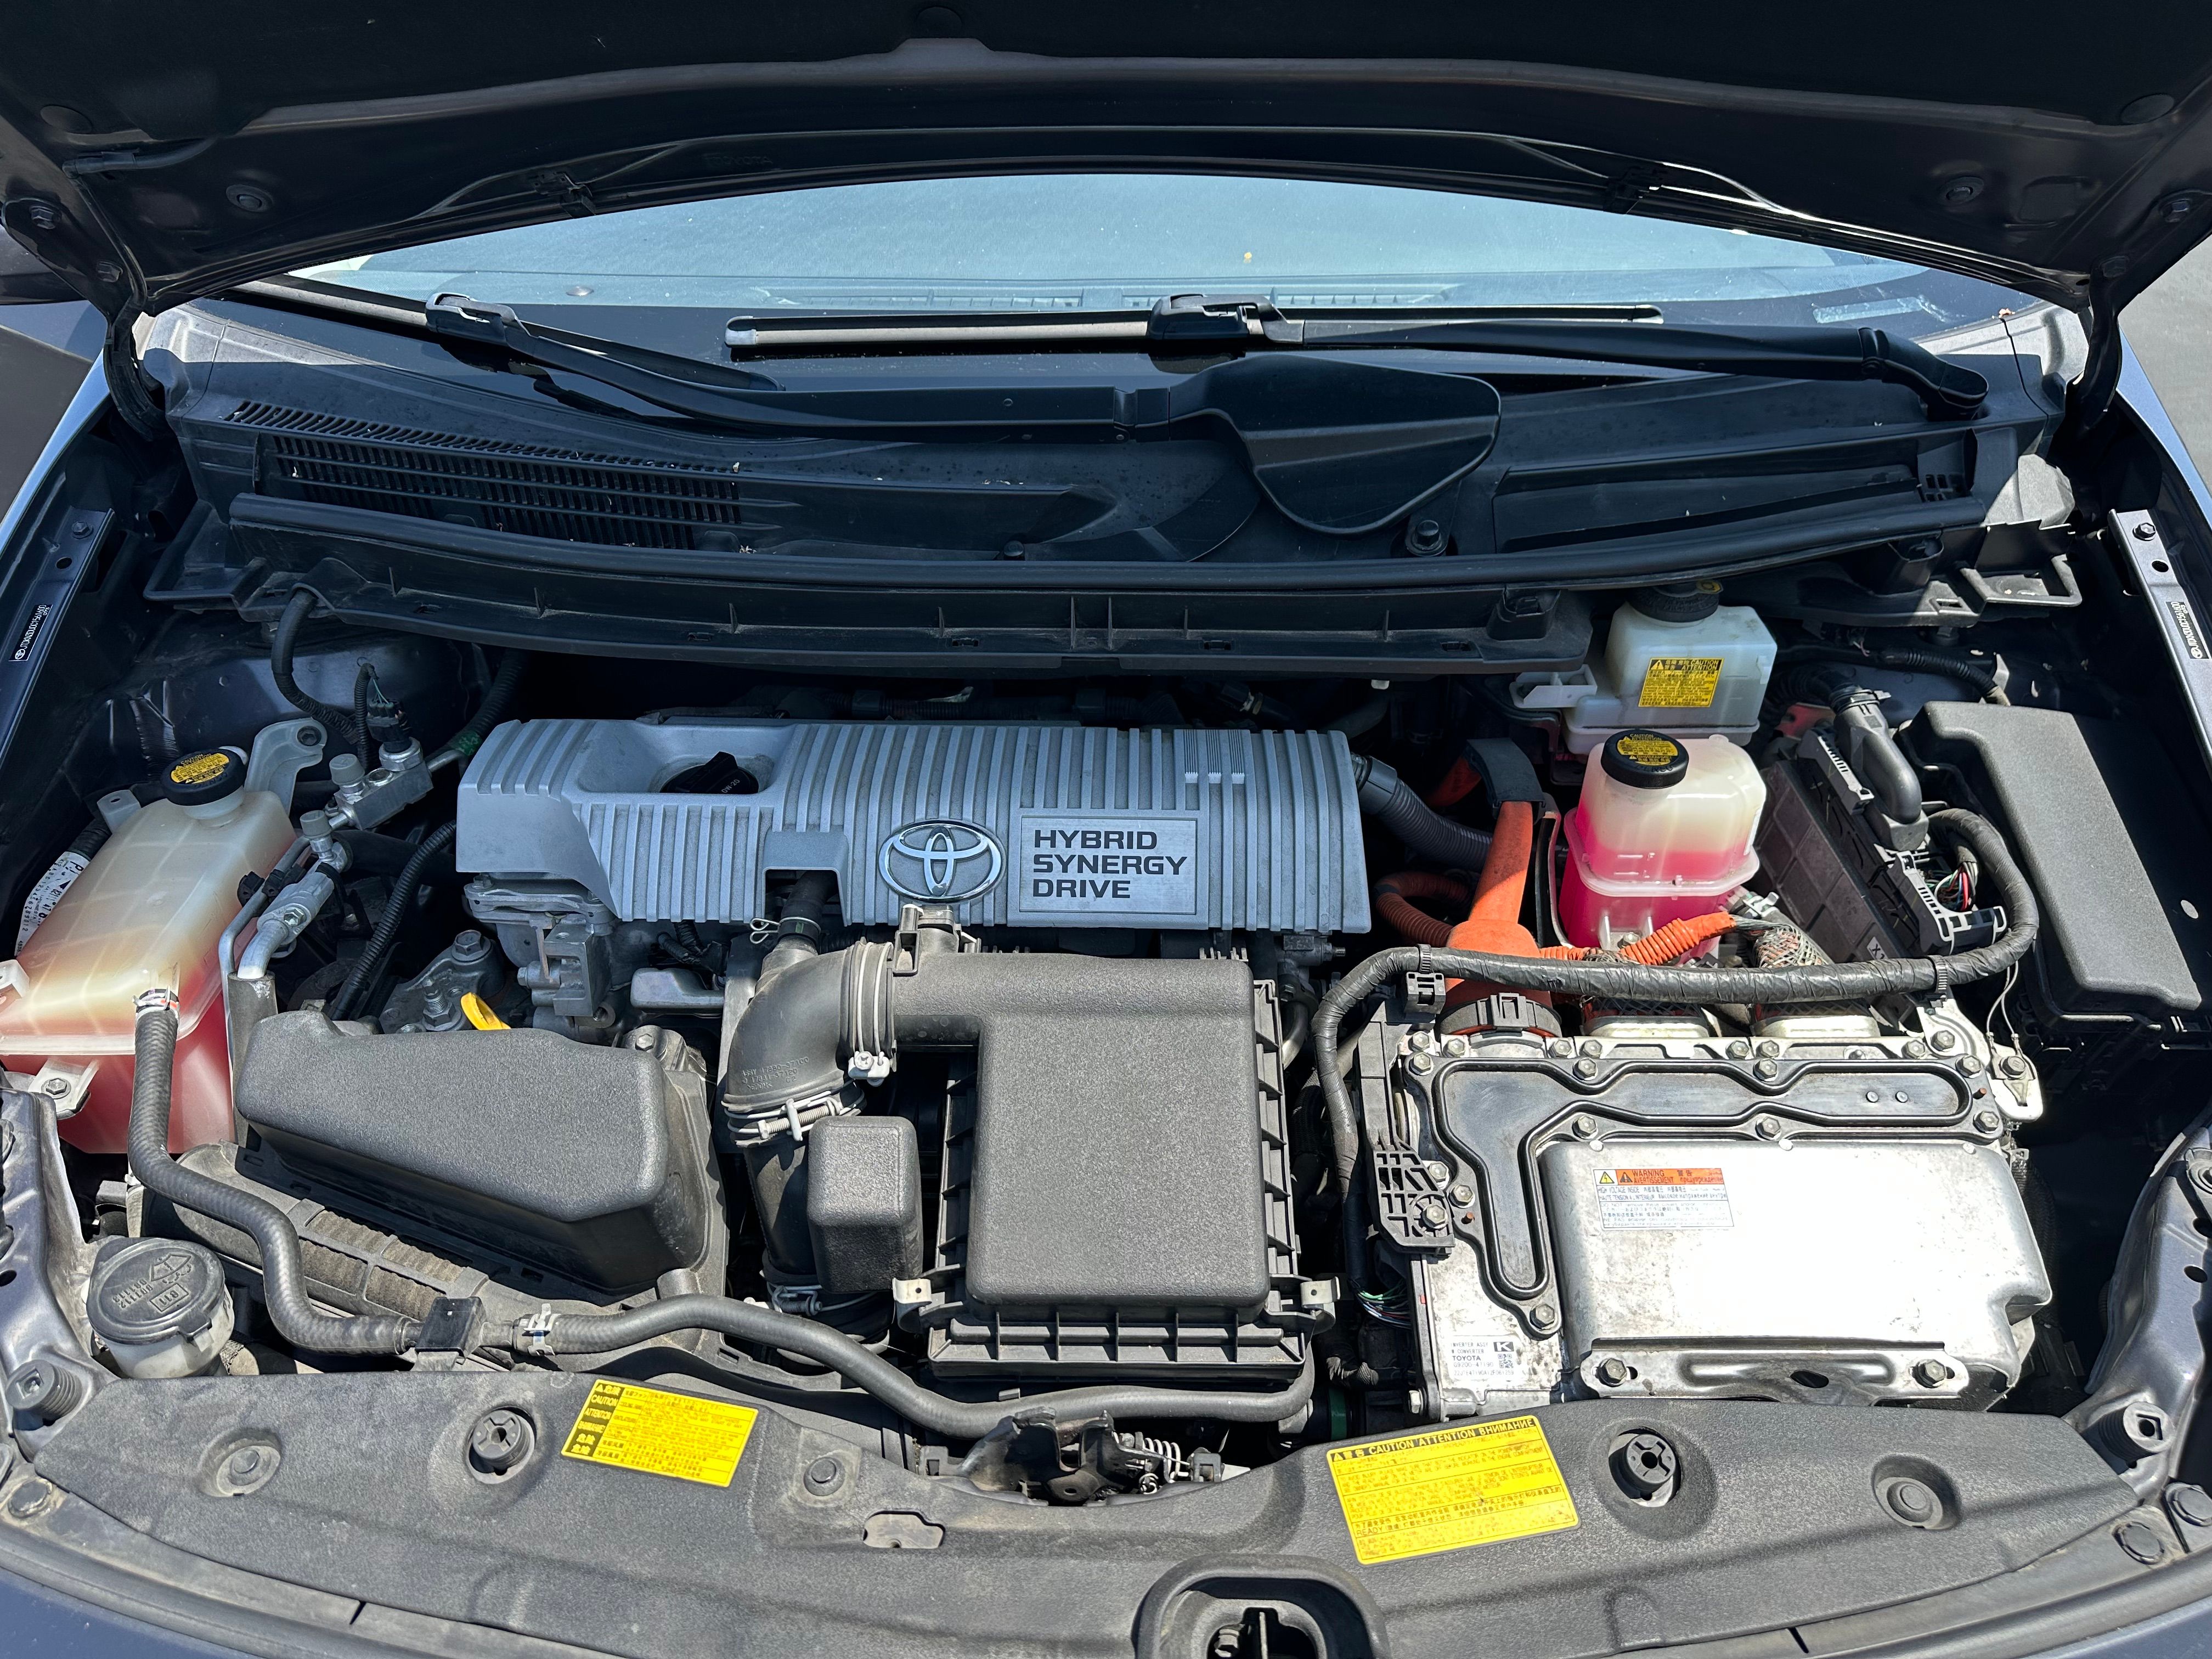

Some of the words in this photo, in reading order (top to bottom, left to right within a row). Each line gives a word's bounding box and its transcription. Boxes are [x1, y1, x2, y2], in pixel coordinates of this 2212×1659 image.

[721, 778, 741, 793] 0W-20
[1034, 830, 1157, 850] HYBRID
[1033, 854, 1188, 875] SYNERGY
[1032, 878, 1131, 899] DRIVE
[760, 1057, 809, 1074] 17880-37100
[590, 1394, 619, 1407] CAUTION
[584, 1408, 613, 1420] ATTENTION
[1479, 1418, 1535, 1435] ВНИМАНИЕ
[1368, 1440, 1414, 1455] CAUTION
[1419, 1429, 1476, 1446] ATTENTION
[1356, 1526, 1384, 1537] READY
